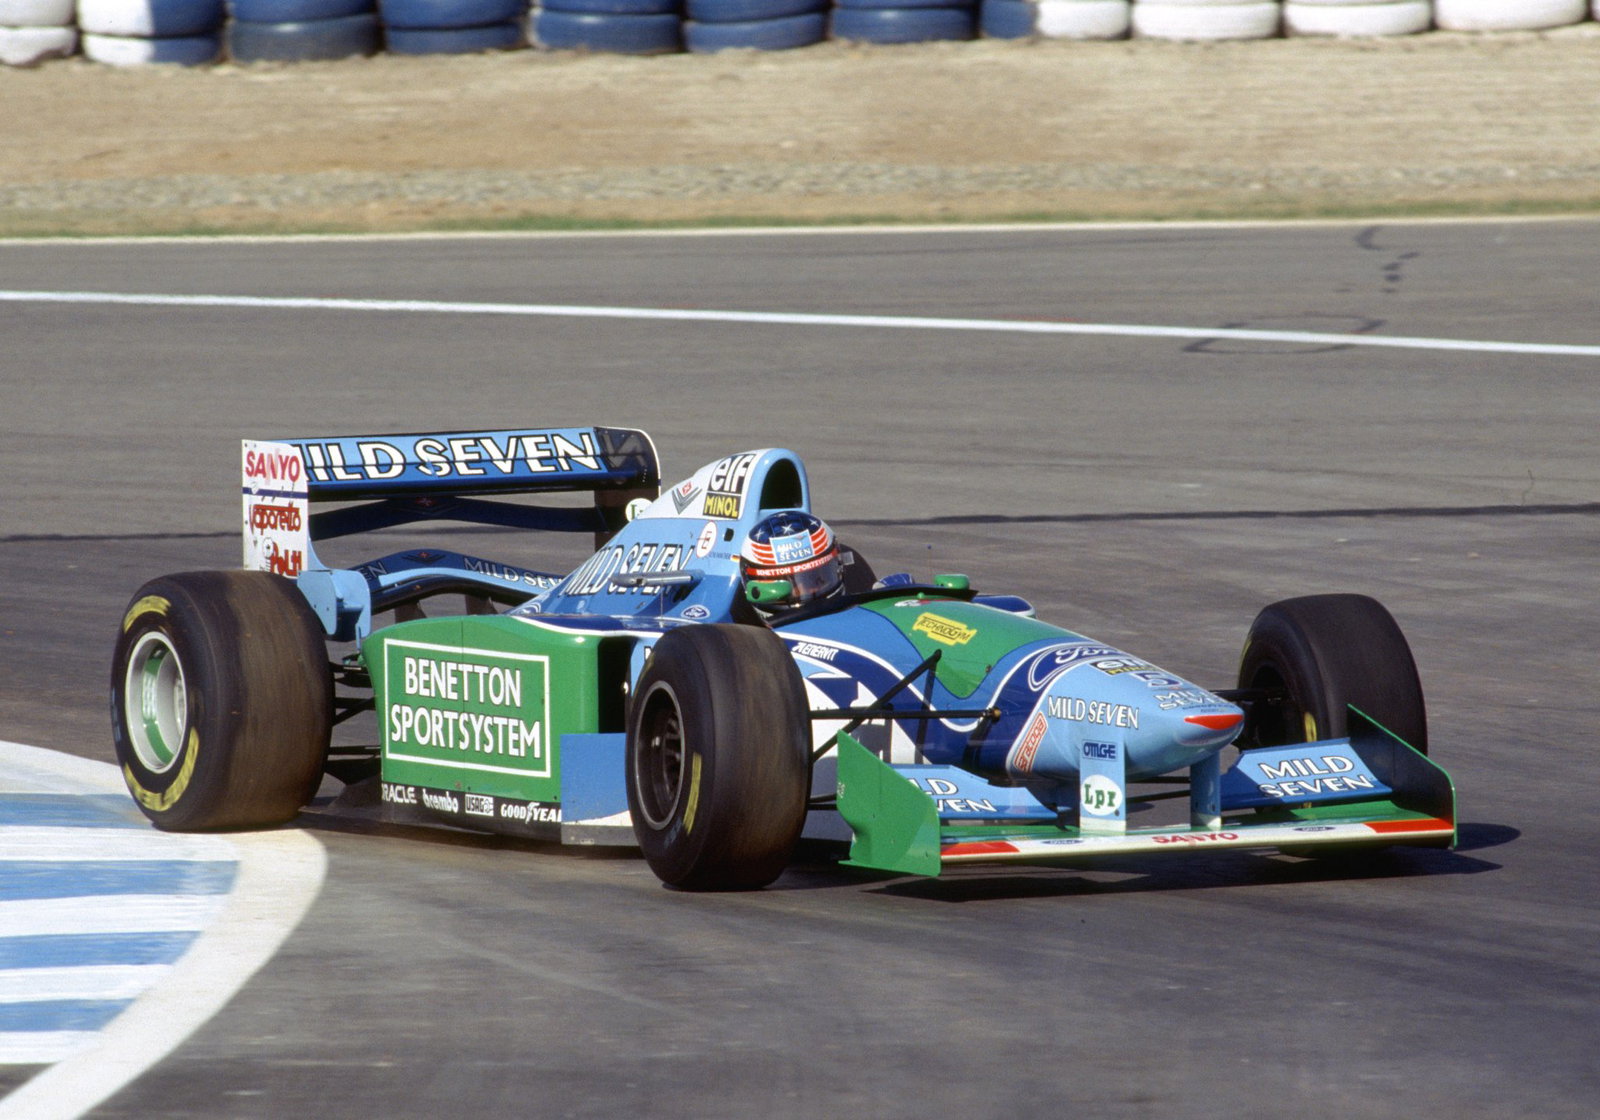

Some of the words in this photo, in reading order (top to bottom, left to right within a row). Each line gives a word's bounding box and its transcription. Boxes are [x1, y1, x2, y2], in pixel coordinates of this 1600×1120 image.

[244, 450, 301, 482] SANYO
[291, 441, 407, 482] ILD
[414, 432, 602, 478] SEVEN
[710, 454, 757, 493] elf
[704, 494, 739, 518] MINOL
[777, 540, 803, 553] MILD
[779, 547, 812, 561] SEVEN
[463, 557, 519, 582] MILD
[522, 570, 565, 589] SEV
[558, 545, 625, 598] MILD
[606, 542, 696, 597] SEVEN
[404, 656, 522, 708] BENETTON
[1132, 671, 1182, 687] 5
[1047, 695, 1086, 722] MILD
[1088, 701, 1140, 731] SEVEN
[390, 704, 542, 760] SPORTSYSTEM
[1257, 754, 1355, 780] MILD
[382, 783, 418, 805] RACLE
[421, 788, 460, 814] brembo
[907, 777, 960, 796] LD
[1258, 774, 1375, 798] SEVEN
[936, 798, 998, 813] VEN
[1151, 831, 1240, 845] SANYO
